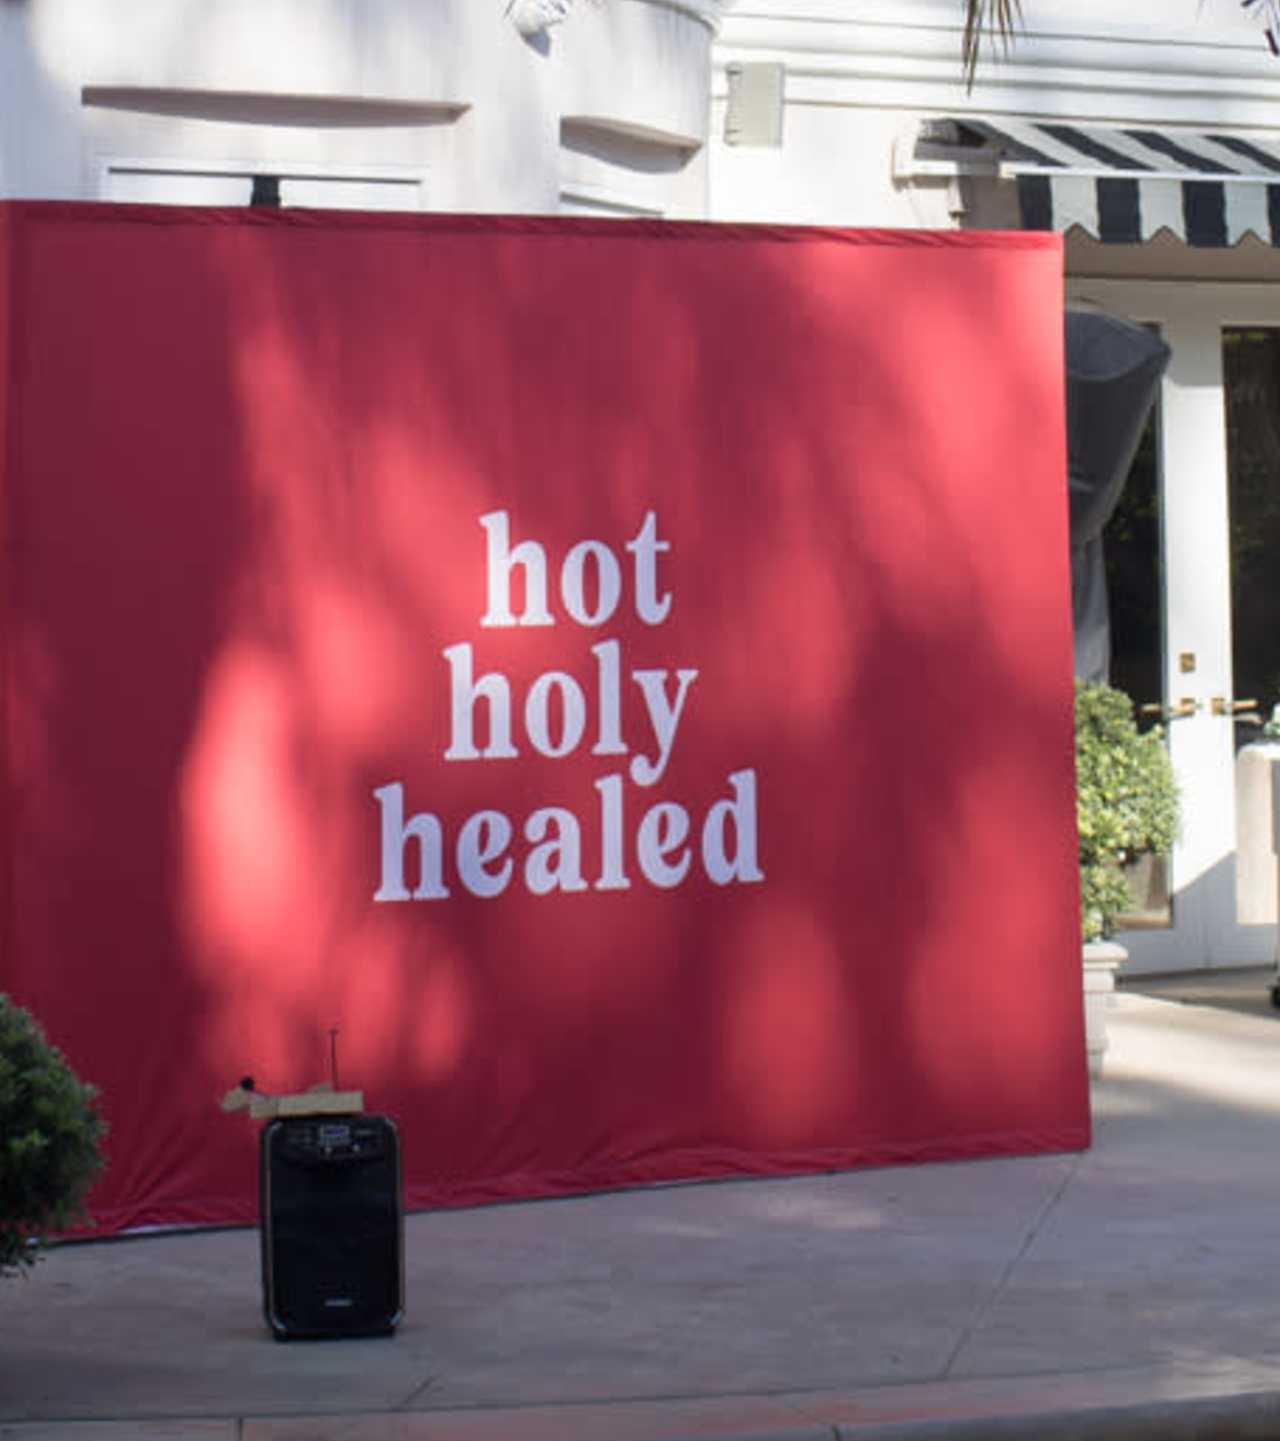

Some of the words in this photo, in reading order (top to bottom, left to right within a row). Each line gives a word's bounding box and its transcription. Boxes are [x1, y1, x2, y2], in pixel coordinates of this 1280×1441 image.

[479, 509, 672, 628] hot
[443, 638, 699, 787] holy
[373, 768, 765, 902] healed
